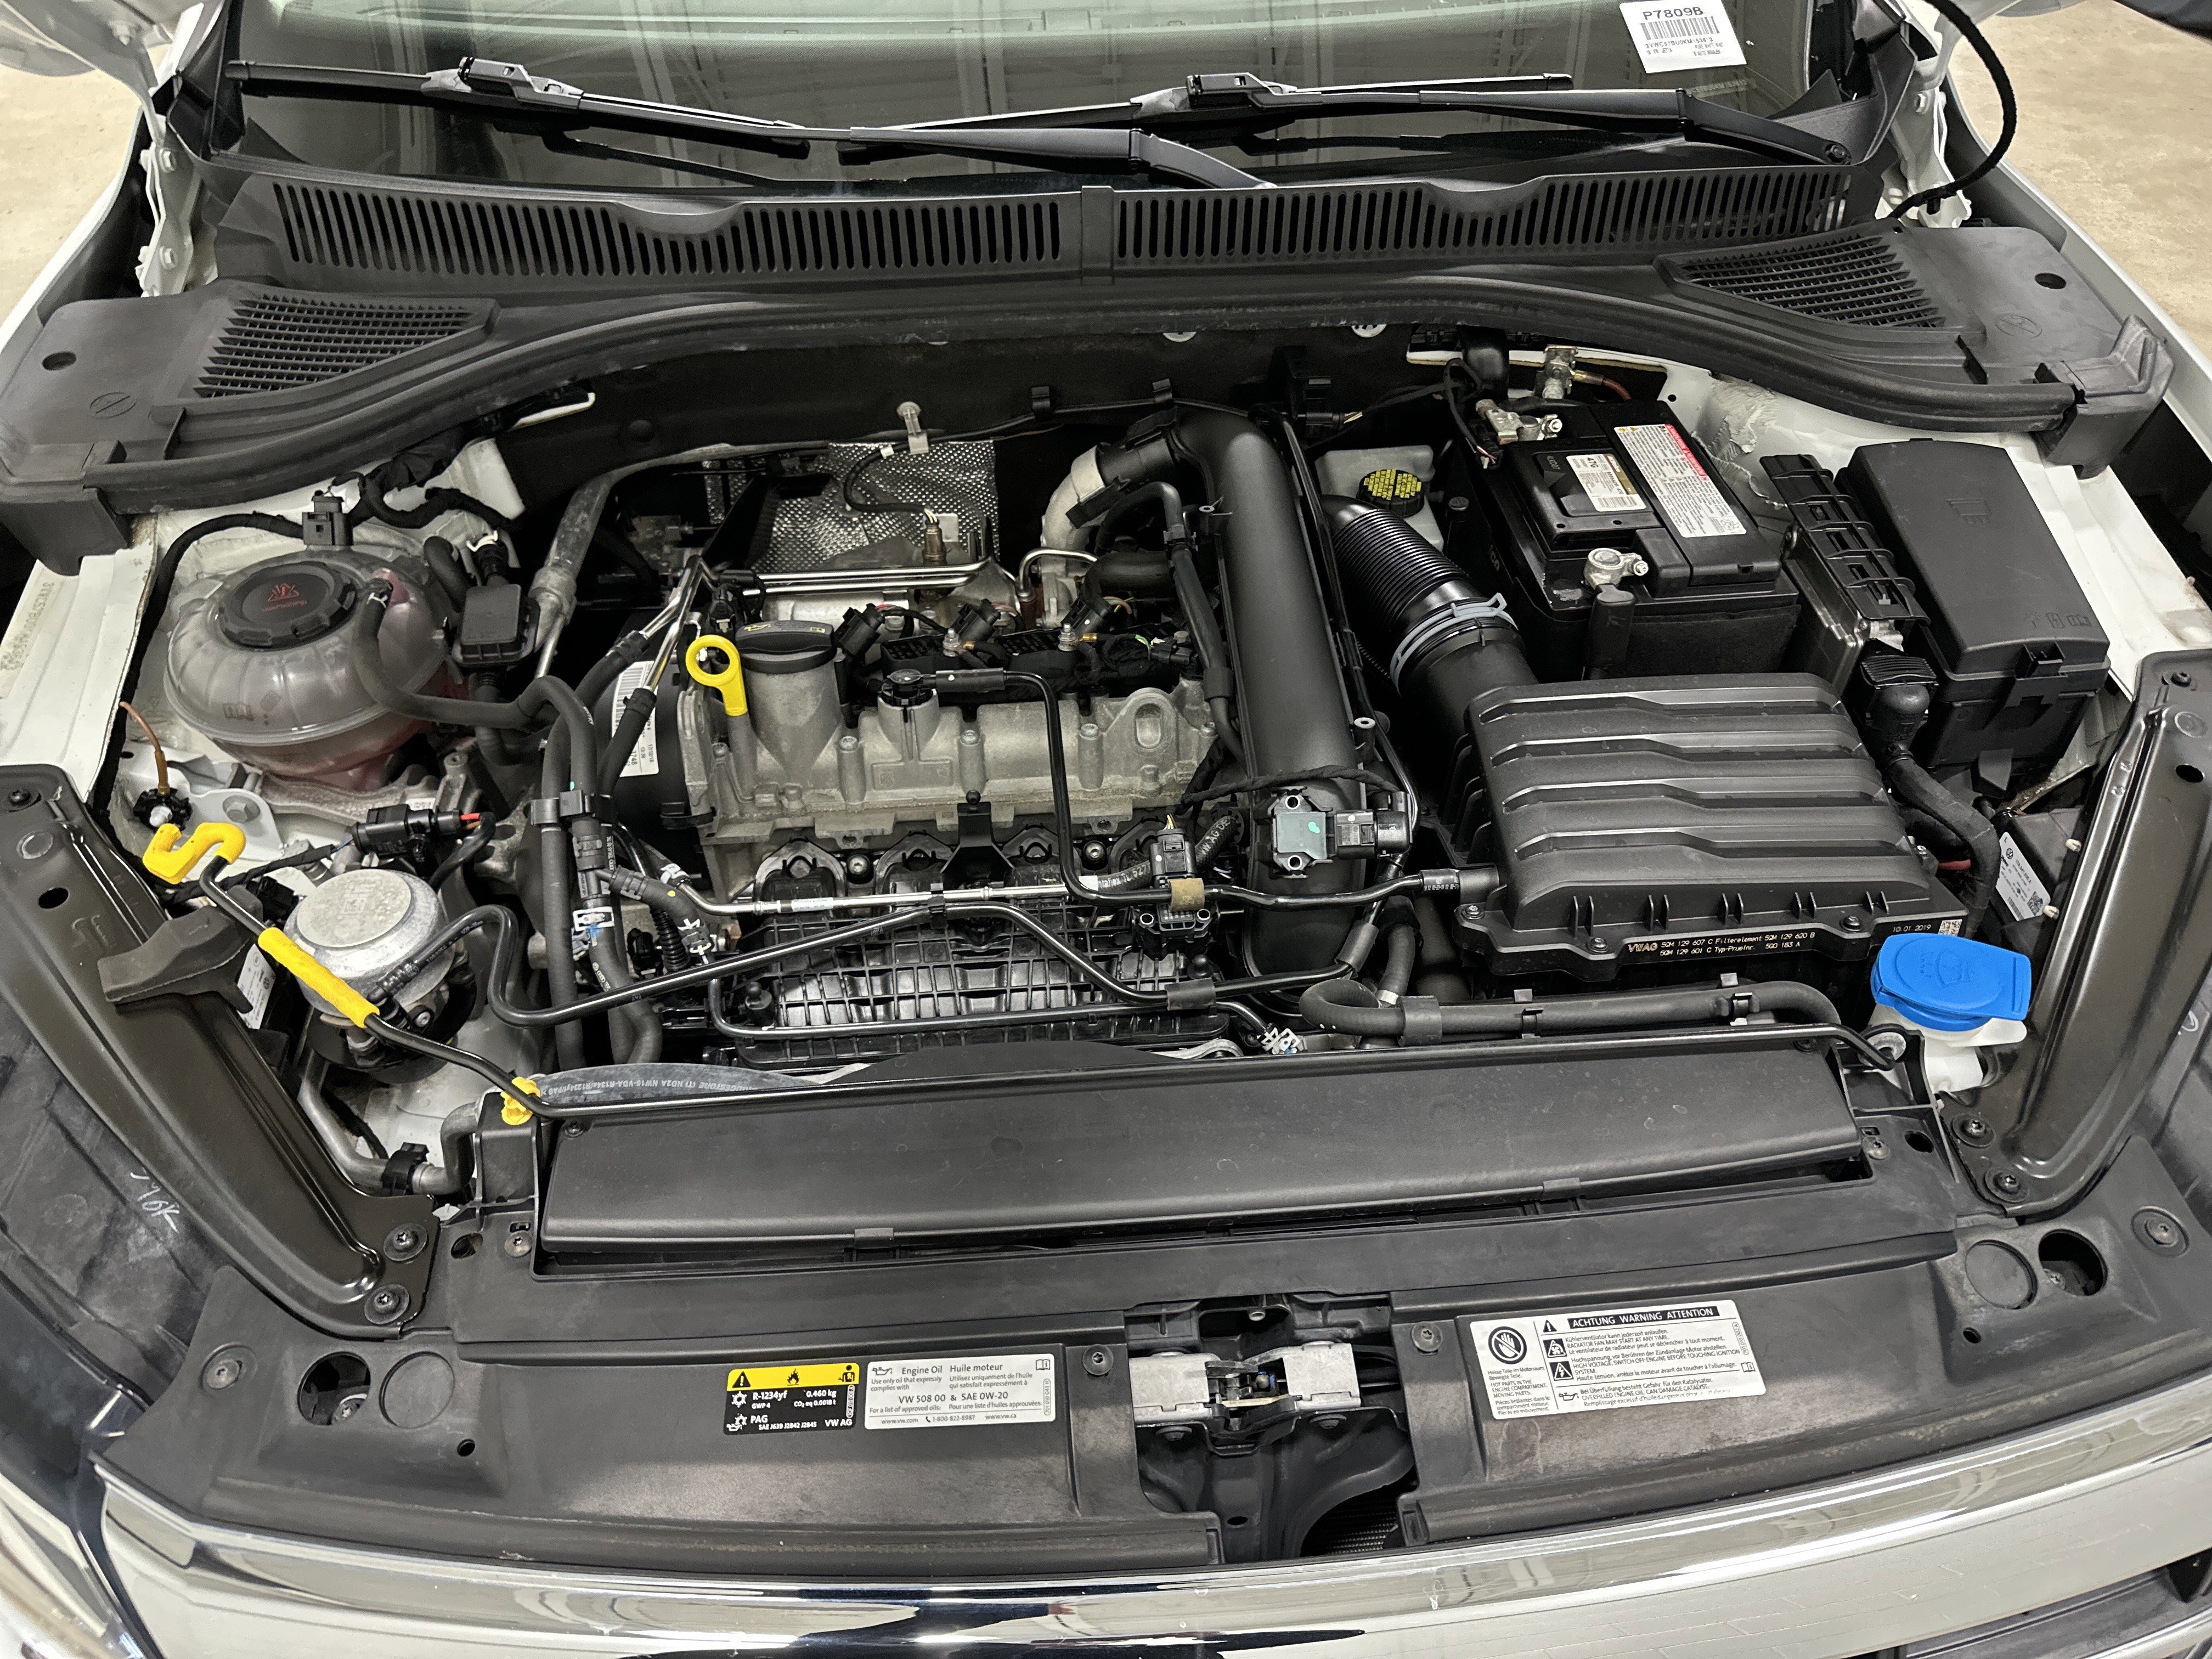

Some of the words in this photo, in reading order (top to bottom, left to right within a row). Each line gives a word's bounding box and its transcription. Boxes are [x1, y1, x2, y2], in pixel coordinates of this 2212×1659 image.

[1643, 7, 1704, 20] P7809B
[1587, 457, 1599, 469] 47G
[1200, 843, 1211, 855] VW
[1209, 831, 1220, 844] AG
[1628, 943, 1657, 952] VWAG
[661, 1080, 684, 1088] ND2A
[699, 1081, 755, 1092] RIDGESTONE
[1573, 1316, 1615, 1327] ACHTUNG
[1619, 1312, 1662, 1322] WARNING
[1667, 1308, 1713, 1318] ATTENTION
[1621, 1330, 1644, 1339] jederzeit
[1655, 1348, 1685, 1356] Zündanlage
[901, 1366, 929, 1376] Engine
[930, 1365, 942, 1373] Oil
[950, 1364, 970, 1372] Huile
[753, 1390, 787, 1401] R-1234yf
[827, 1389, 837, 1398] kg
[934, 1393, 946, 1402] 00
[961, 1392, 977, 1401] SAE
[979, 1391, 1008, 1400] 0W-20
[901, 1404, 928, 1413] approved
[750, 1414, 768, 1423] PAG
